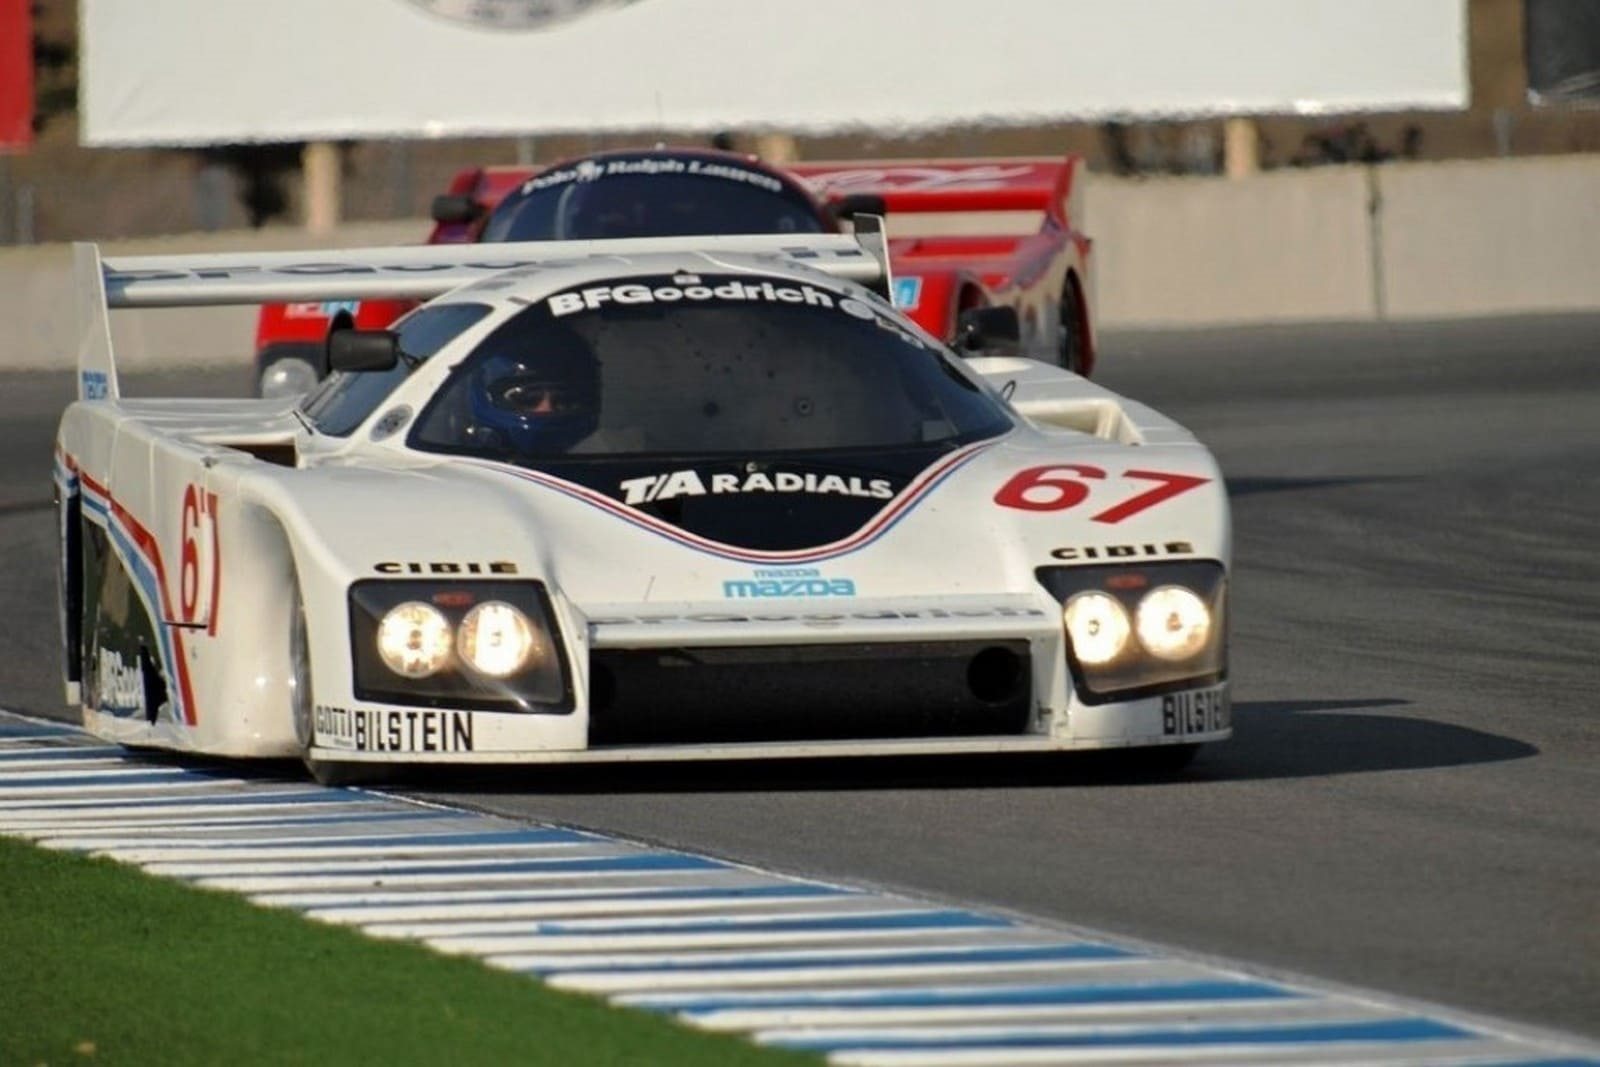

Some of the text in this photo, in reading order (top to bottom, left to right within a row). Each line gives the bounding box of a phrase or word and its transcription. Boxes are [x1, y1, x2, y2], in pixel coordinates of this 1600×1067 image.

[548, 280, 835, 317] BFGoodrich
[620, 470, 894, 504] T/A RADIALS
[993, 464, 1213, 524] 67
[181, 483, 220, 638] 67
[373, 562, 518, 574] CIBIE
[1051, 542, 1195, 559] CIBIE
[723, 579, 856, 597] mazda
[355, 711, 473, 751] BILSTEIN
